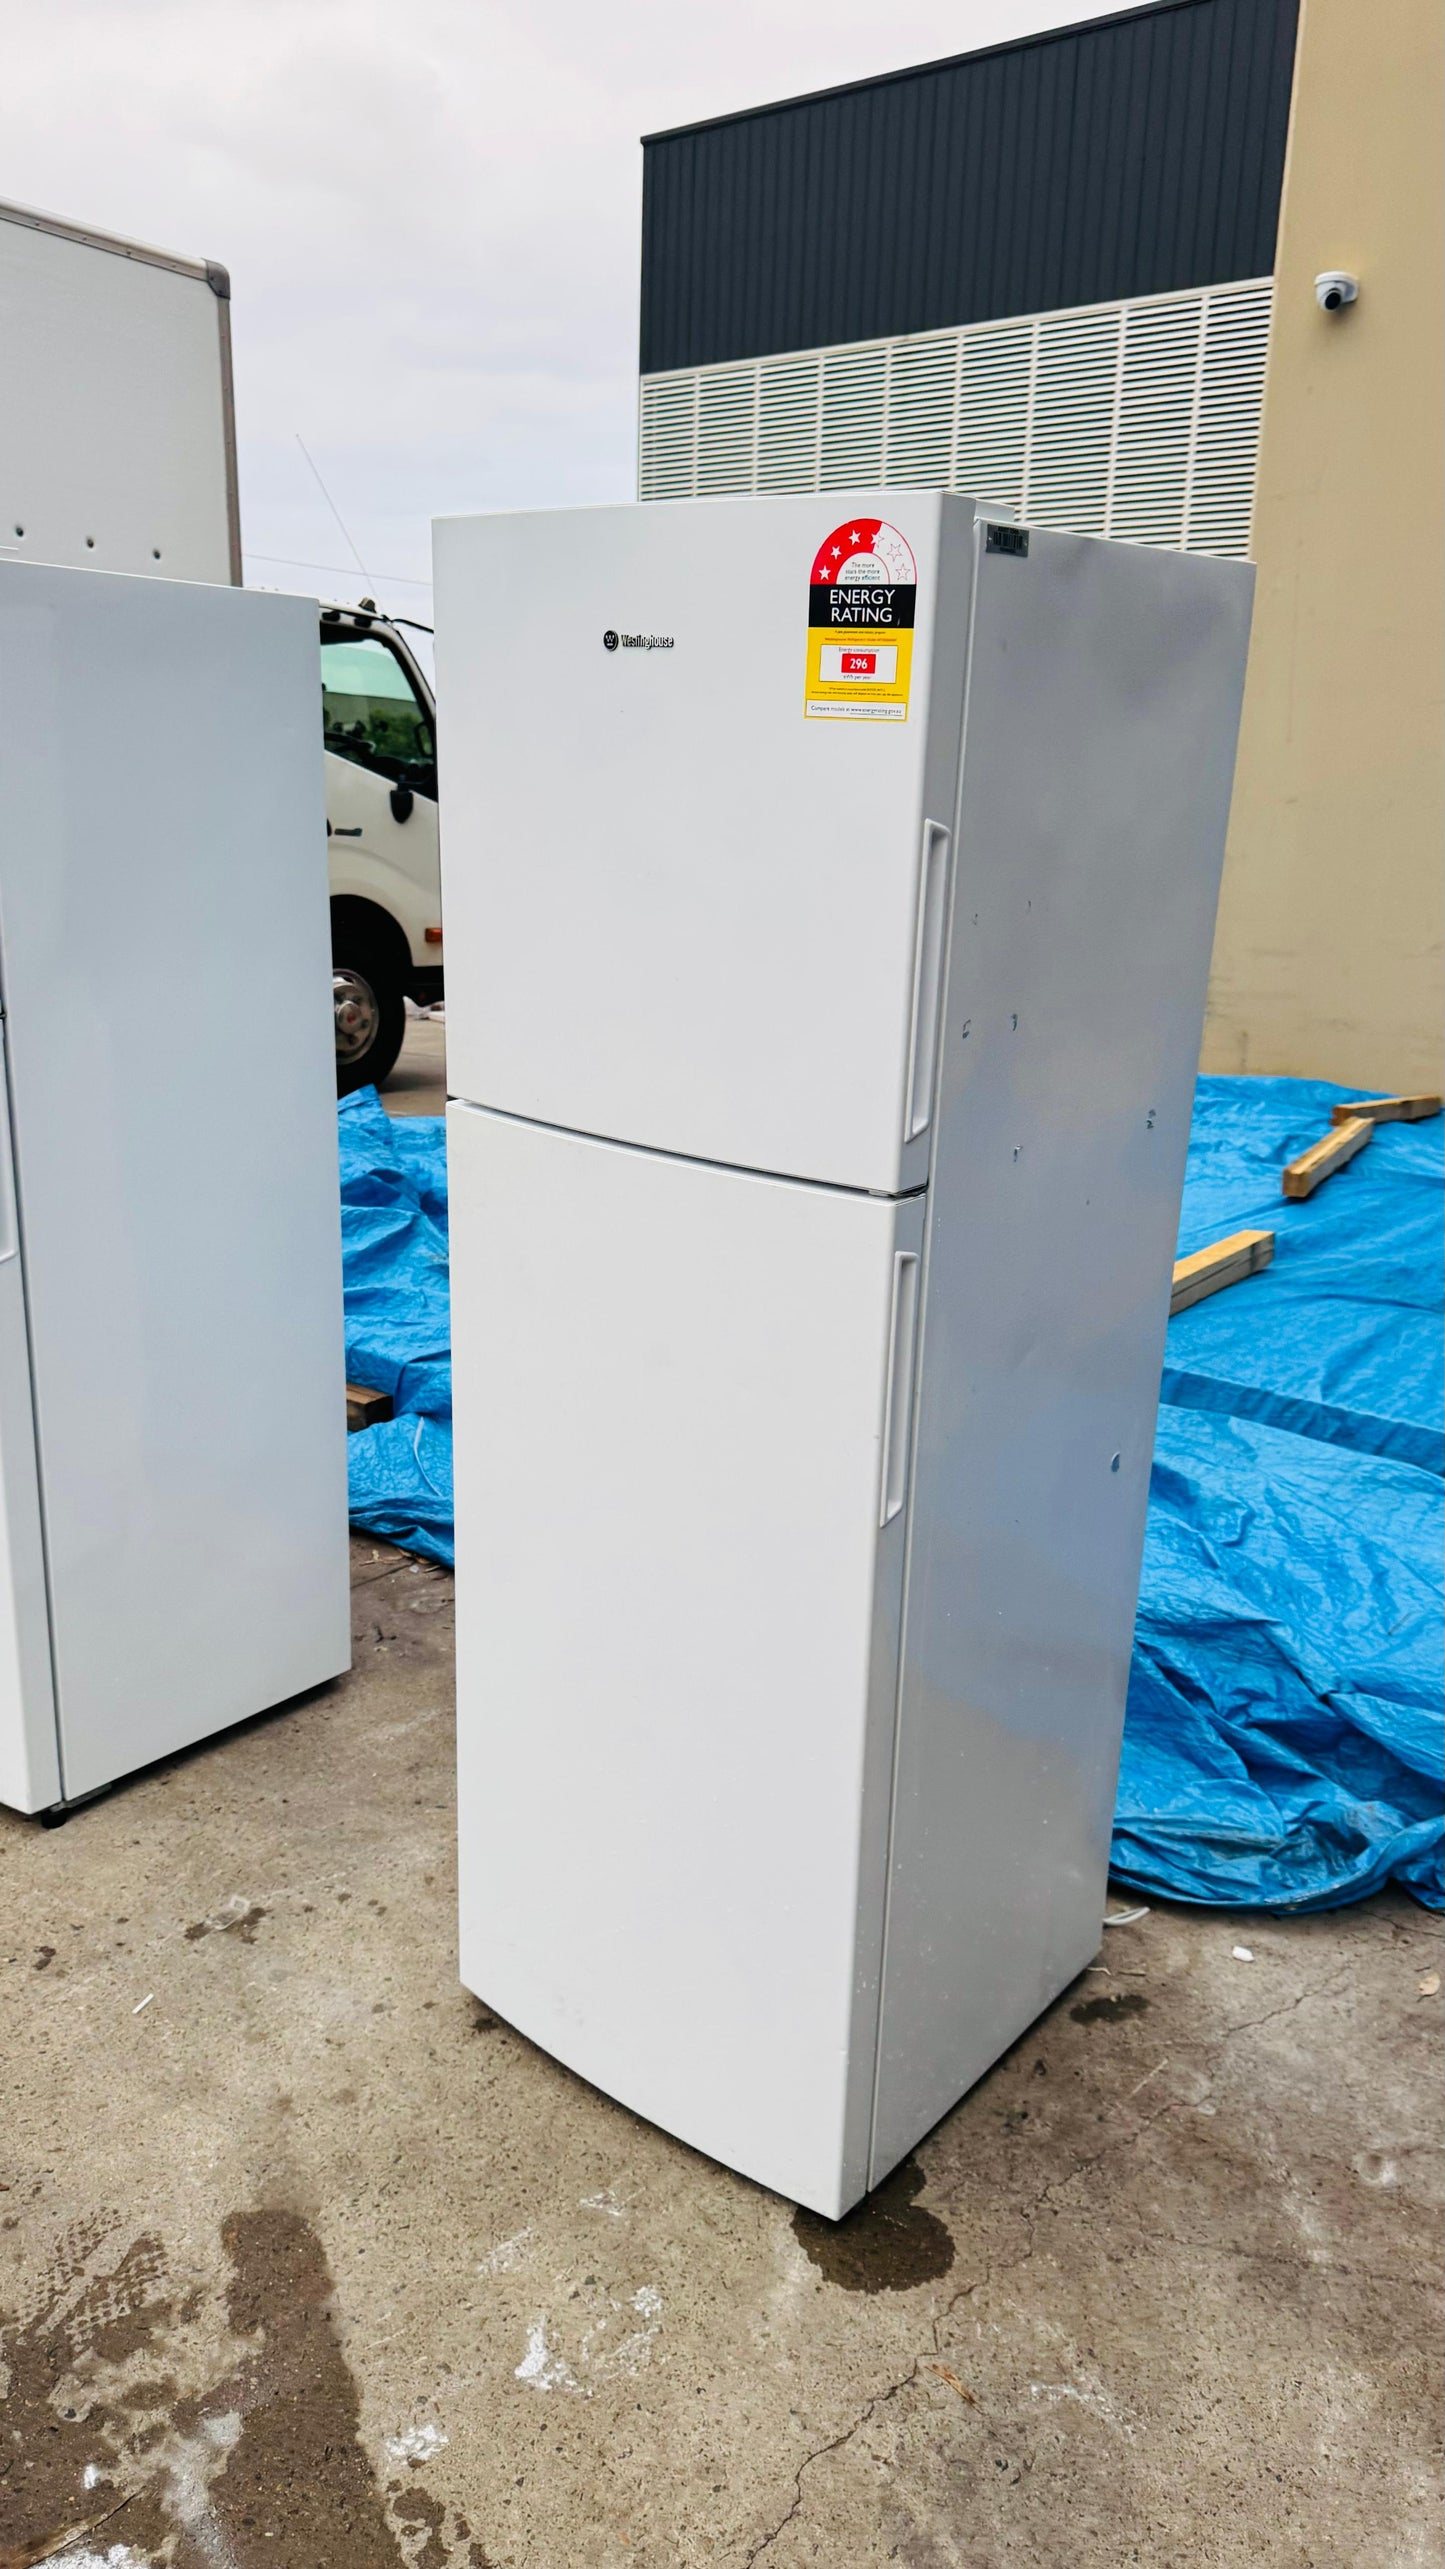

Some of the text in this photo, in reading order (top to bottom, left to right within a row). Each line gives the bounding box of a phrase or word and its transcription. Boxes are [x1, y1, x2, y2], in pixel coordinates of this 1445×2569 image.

[829, 589, 895, 604] ENERGY
[831, 607, 892, 622] RATING
[621, 634, 674, 649] Westinghouse
[850, 658, 868, 669] 296
